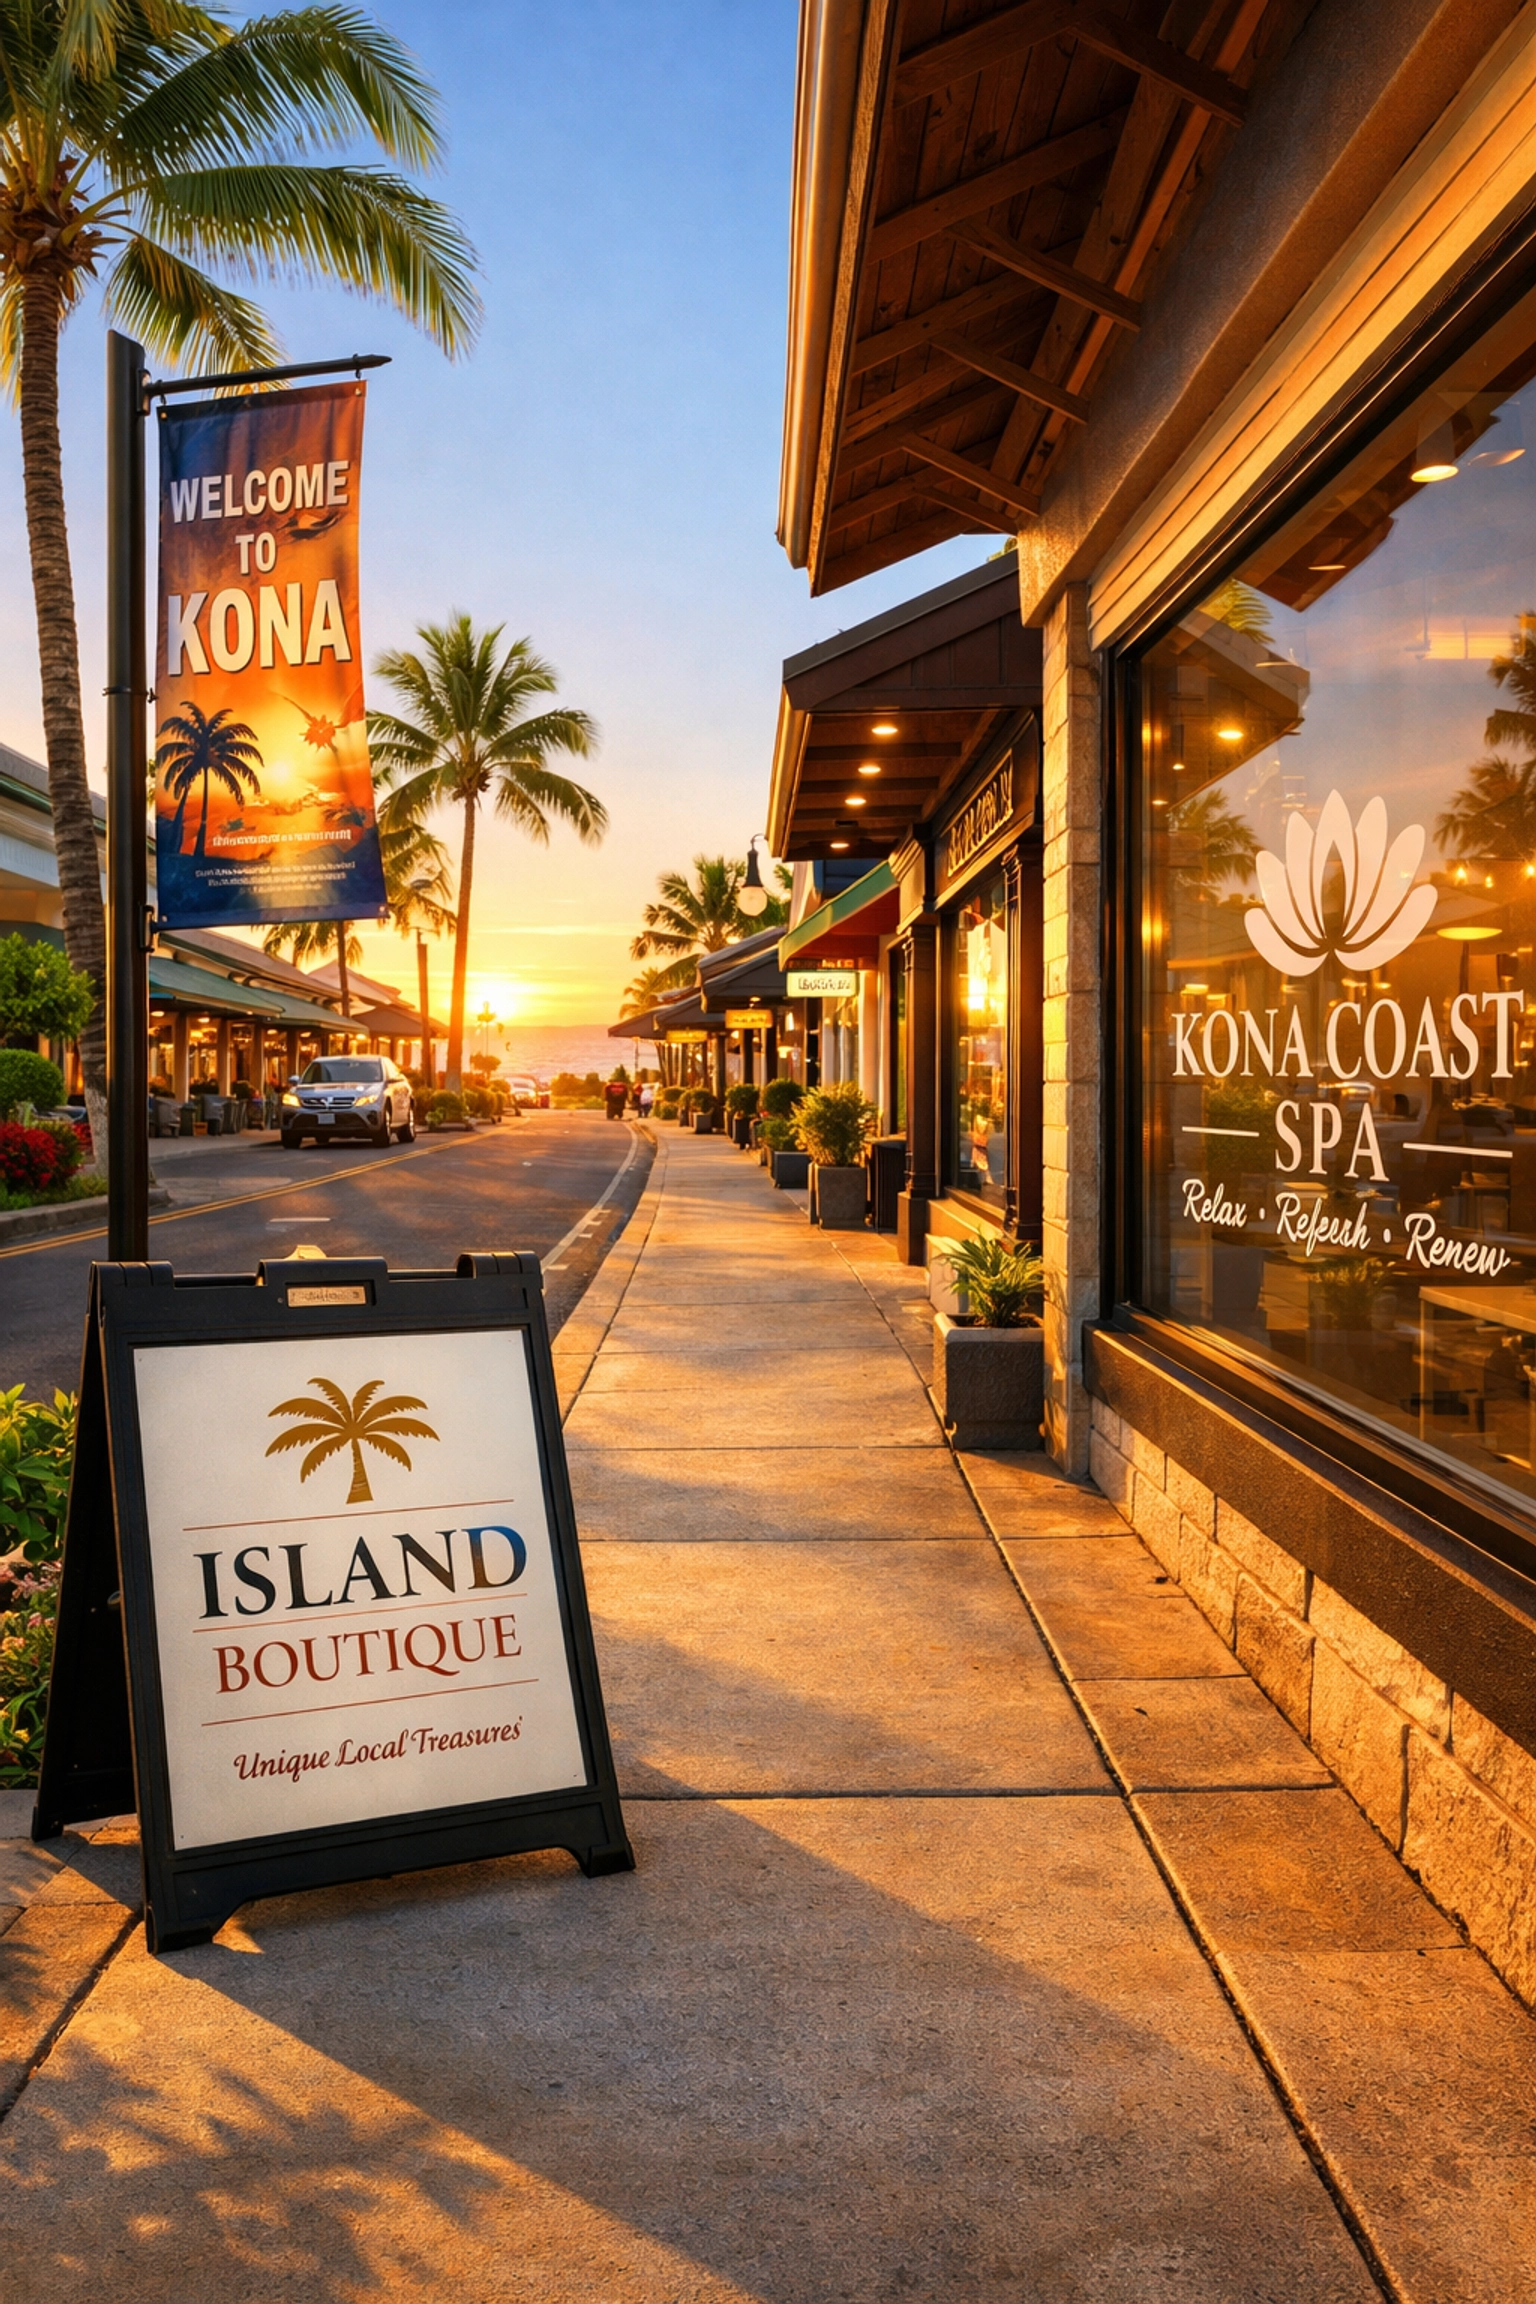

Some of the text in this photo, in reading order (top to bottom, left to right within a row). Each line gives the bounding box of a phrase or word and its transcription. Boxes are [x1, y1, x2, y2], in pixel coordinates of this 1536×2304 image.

[170, 460, 349, 523] WELCOME
[235, 532, 276, 575] TO
[167, 579, 352, 677] KONA
[1171, 989, 1524, 1080] KONA COAST
[1275, 1100, 1390, 1182] SPA
[1182, 1178, 1247, 1227] Relax
[1405, 1213, 1511, 1276] Renew
[193, 1525, 527, 1619] ISLAND
[212, 1614, 522, 1694] BOUTIQUE
[233, 1749, 330, 1783] Unique
[335, 1728, 408, 1767] Local
